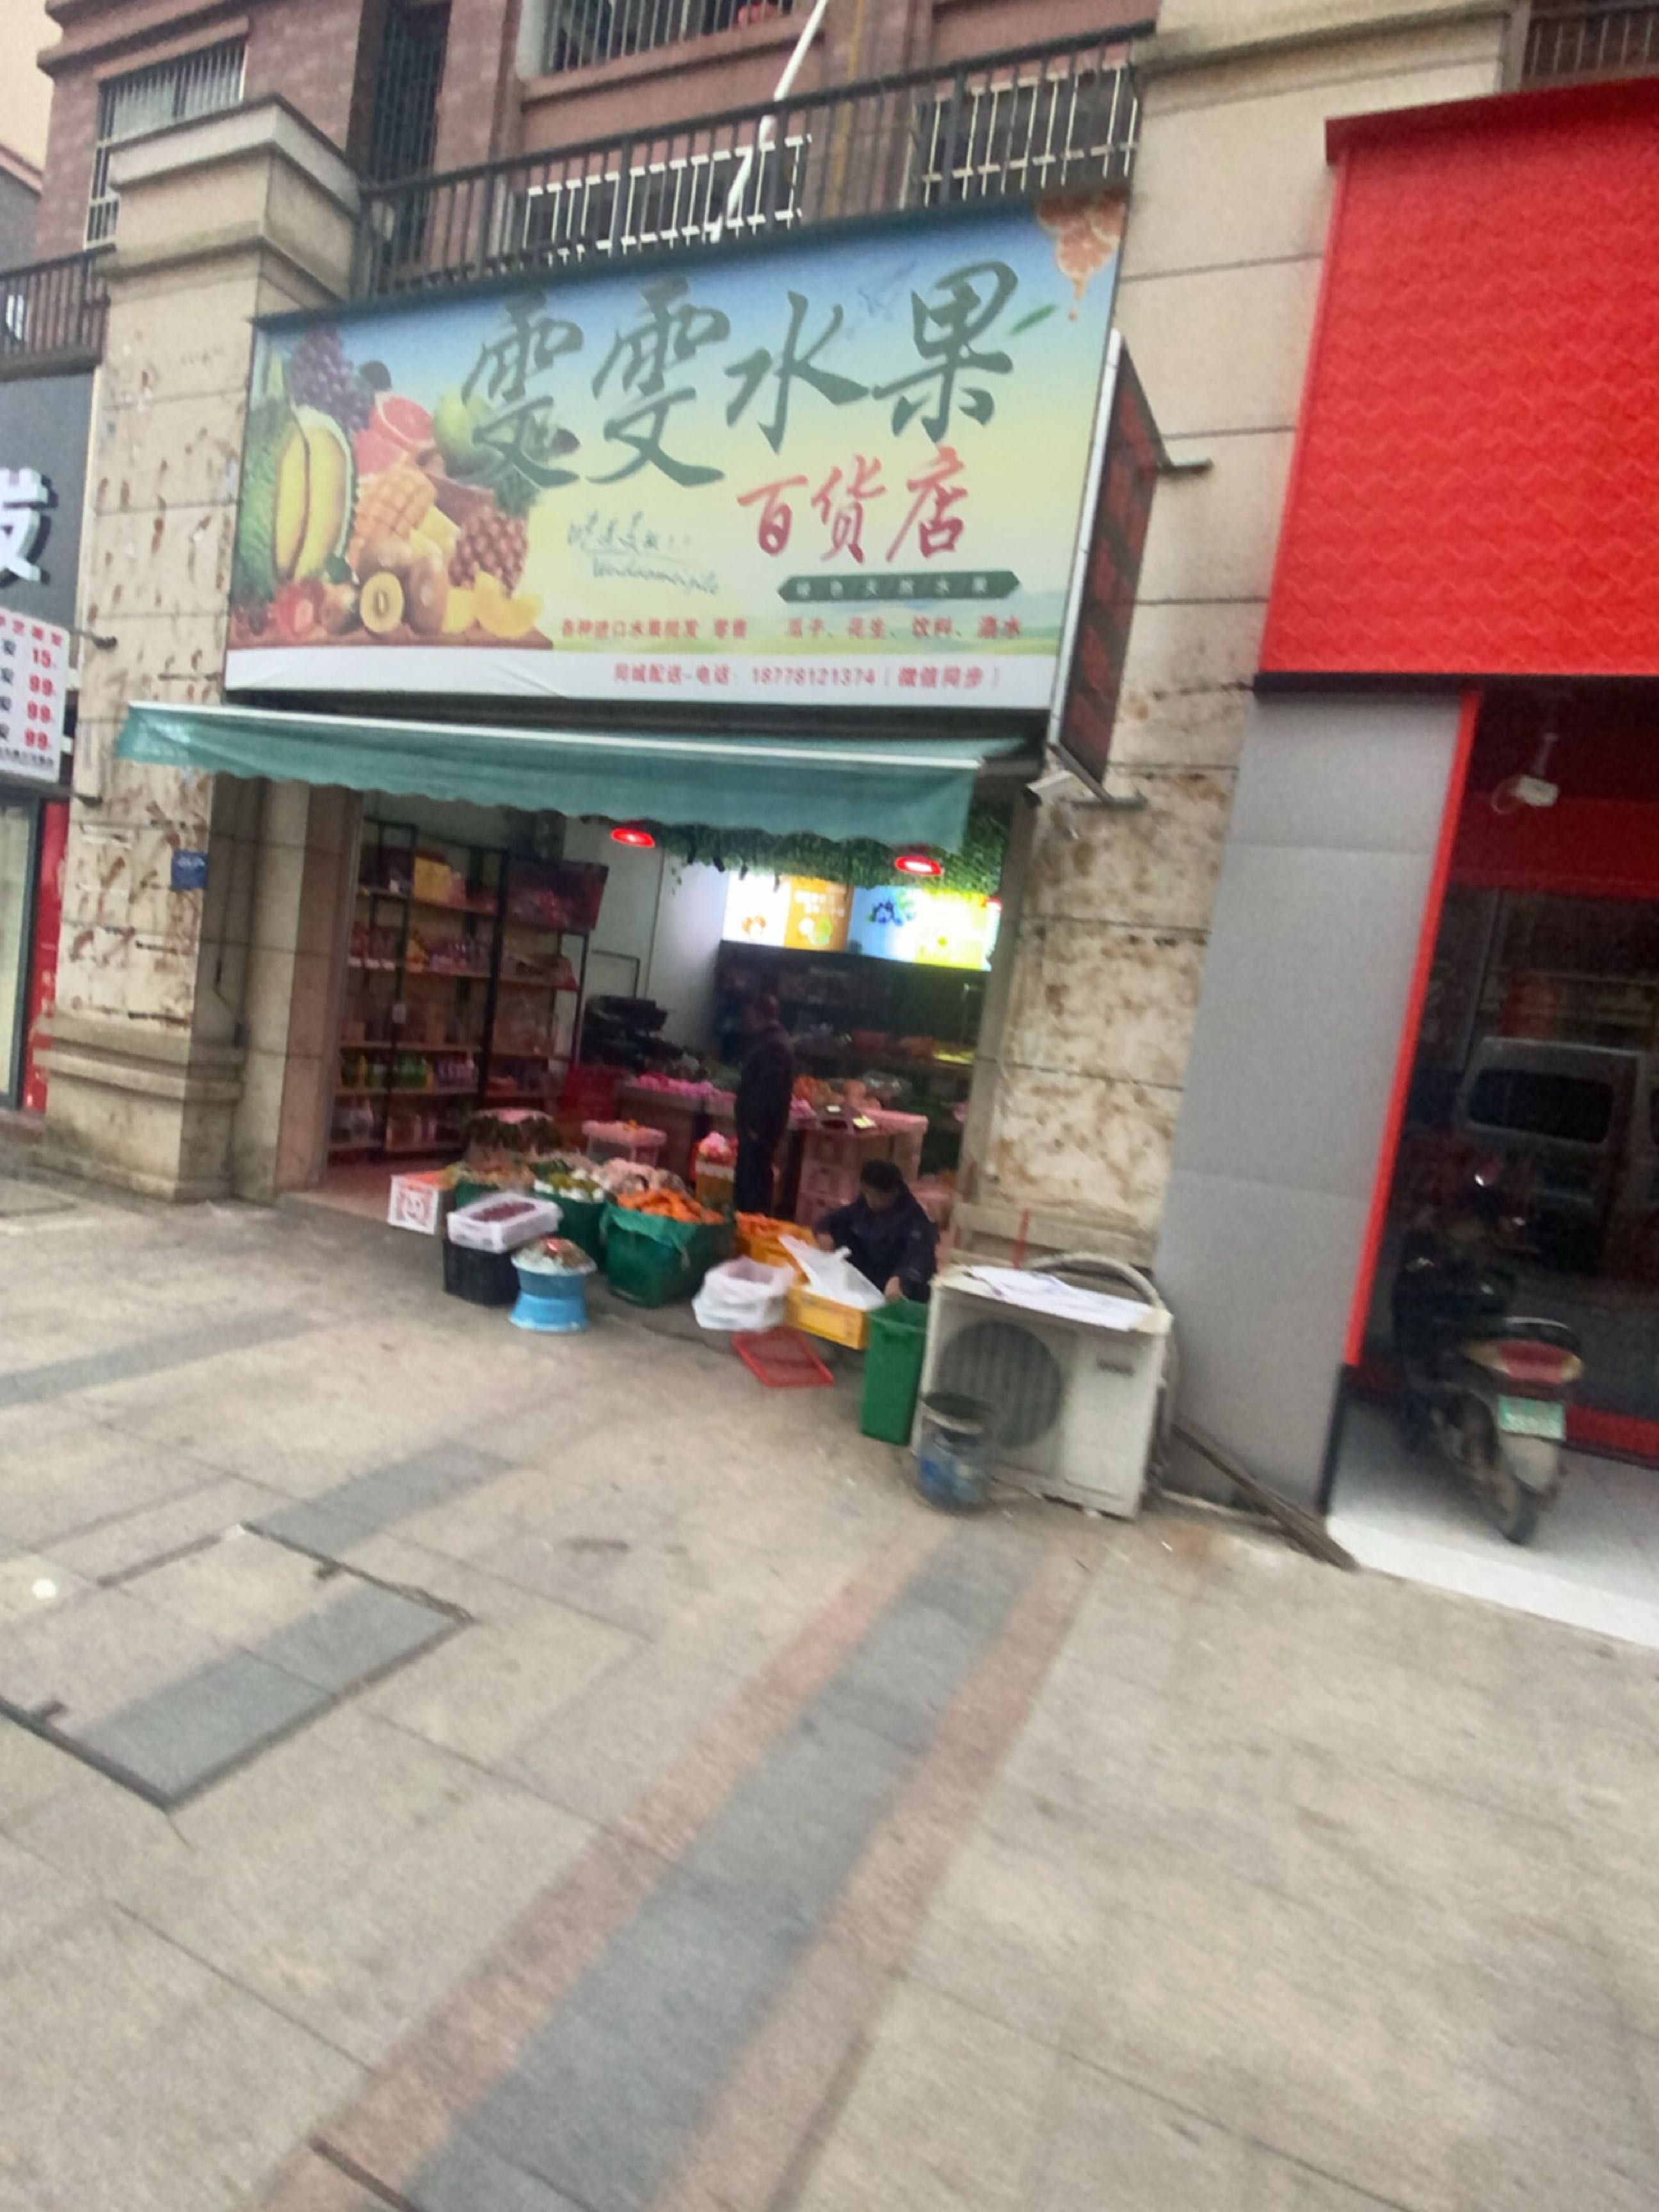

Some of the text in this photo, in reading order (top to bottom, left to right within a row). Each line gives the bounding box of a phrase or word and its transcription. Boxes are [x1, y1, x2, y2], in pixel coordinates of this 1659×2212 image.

[461, 261, 1018, 488] 雯雯水果
[737, 444, 968, 564] 百货店
